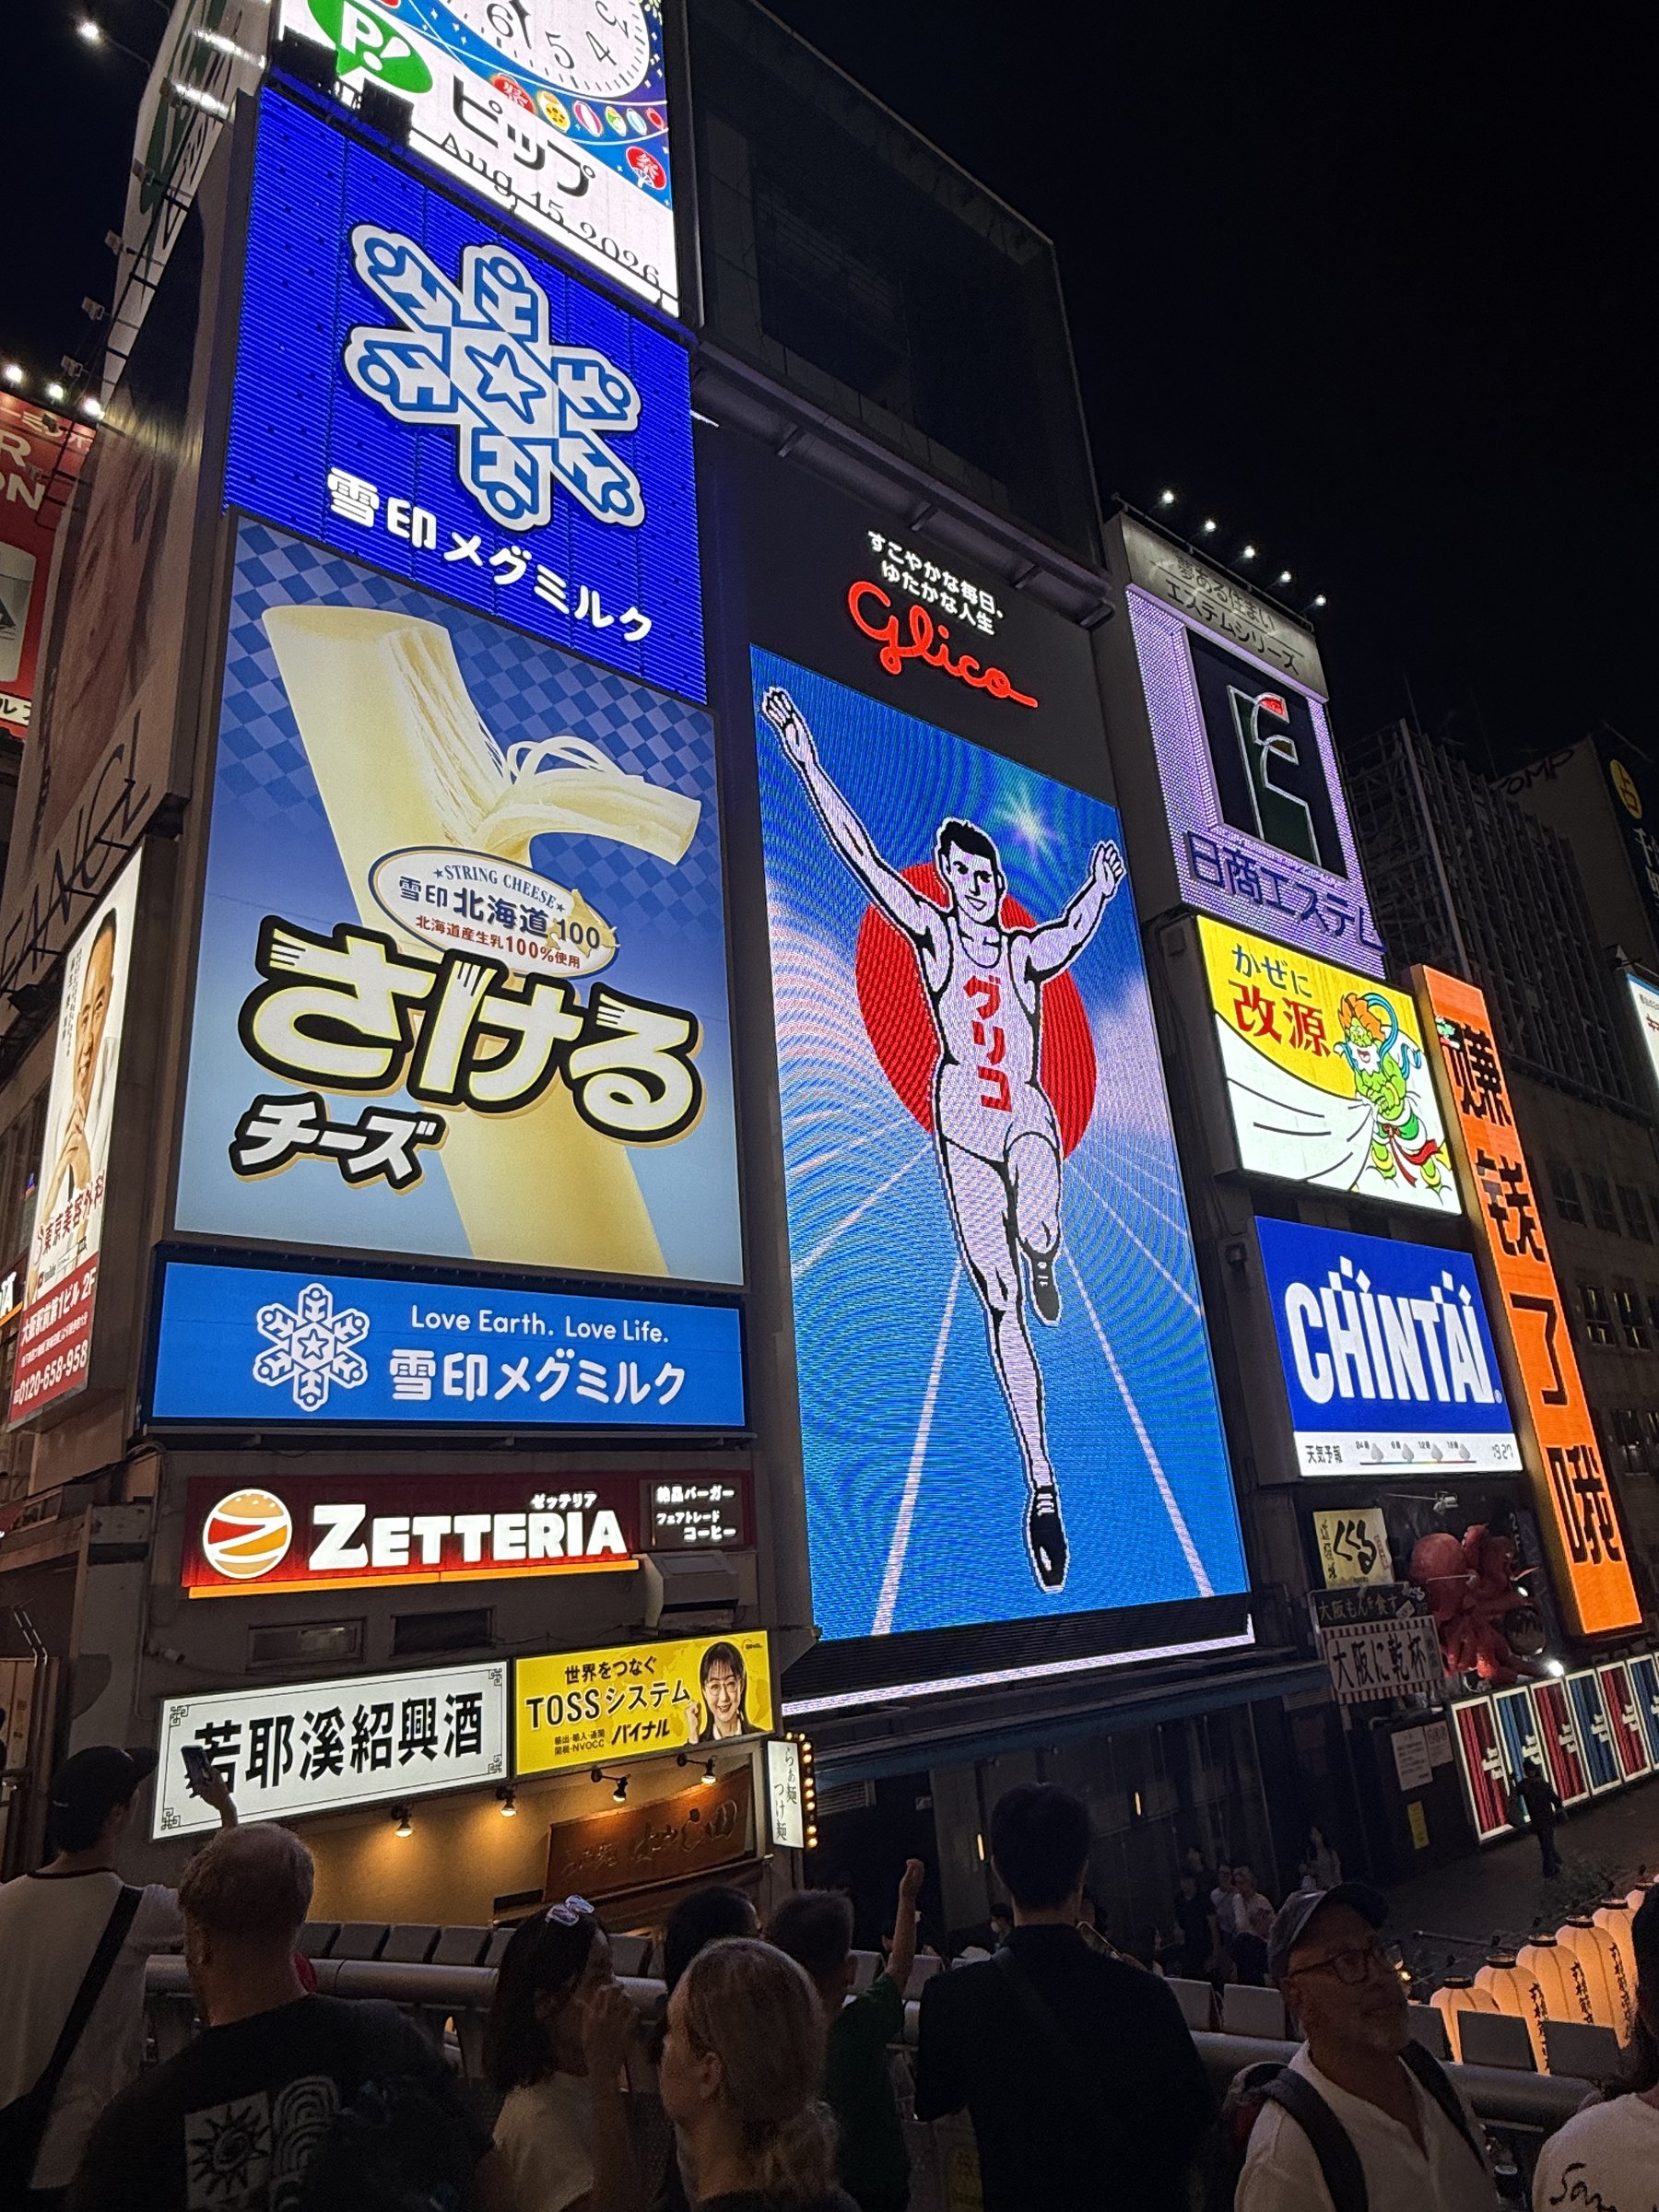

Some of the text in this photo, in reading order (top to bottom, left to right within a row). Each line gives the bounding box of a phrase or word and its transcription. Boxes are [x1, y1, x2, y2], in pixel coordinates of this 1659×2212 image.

[545, 31, 575, 69] 5
[585, 30, 617, 66] 4
[453, 75, 596, 197] ピップ
[440, 133, 512, 197] Aug
[579, 220, 660, 289] 2026
[326, 467, 653, 643] 雪印メグミルク
[881, 560, 995, 636] ゆたかな人生
[848, 581, 1039, 709] Glico
[444, 865, 557, 909] STRING CHEESE
[415, 914, 581, 970] 北海道産生乳100%使用
[1230, 942, 1314, 1000] かぜに
[249, 924, 698, 1135] さける
[962, 974, 1013, 1112] グリコ
[1228, 979, 1333, 1060] 改源
[238, 1097, 439, 1183] チーズ
[410, 1304, 669, 1343] Love Earth. Love Life.
[1284, 1255, 1498, 1405] CHINTAI
[388, 1347, 687, 1406] 雪印メグミルク
[530, 1491, 598, 1510] ゼッテリア
[309, 1503, 629, 1571] ZETTERIA
[683, 1524, 737, 1541] コーヒー
[564, 1654, 657, 1685] 世界をつなぐ
[525, 1678, 691, 1730] TOSSシステム
[610, 1718, 670, 1746] バイナル
[773, 1783, 787, 1841] つけ麺
